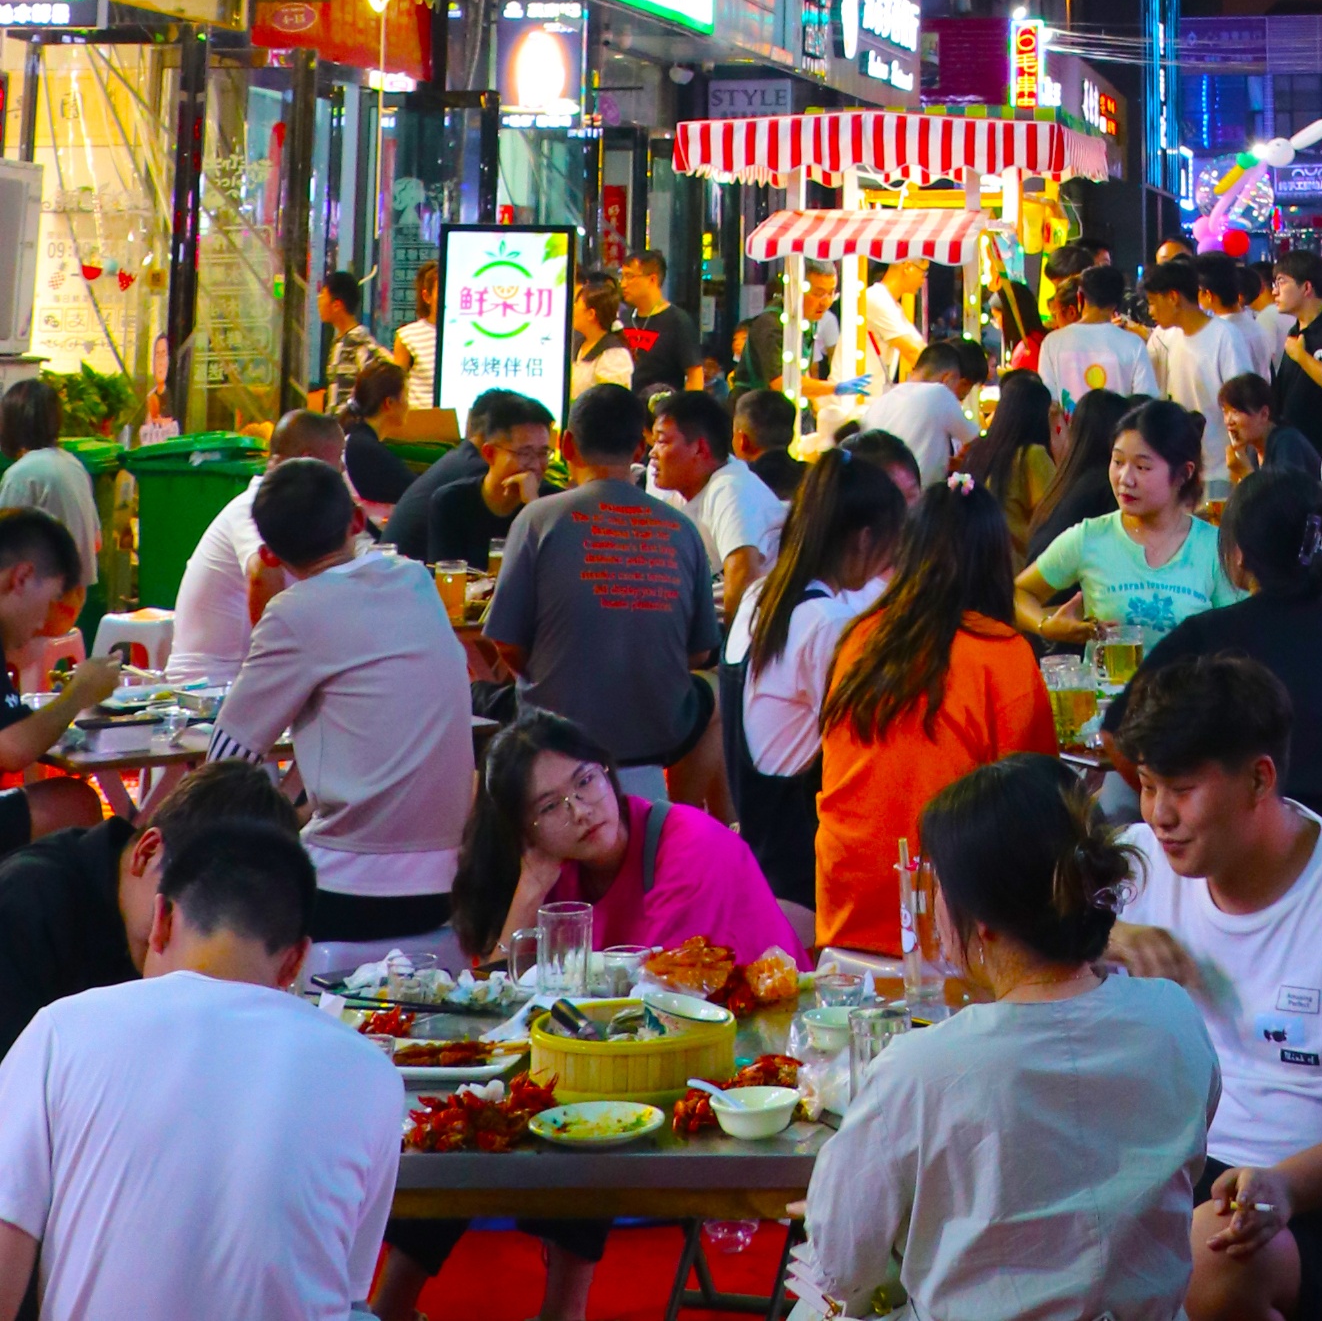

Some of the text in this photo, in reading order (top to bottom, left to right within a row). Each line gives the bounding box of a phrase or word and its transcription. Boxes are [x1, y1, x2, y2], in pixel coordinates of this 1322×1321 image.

[711, 88, 787, 107] STYLE
[459, 285, 553, 318] 鲜果切
[460, 357, 543, 378] 烧烤伴侣
